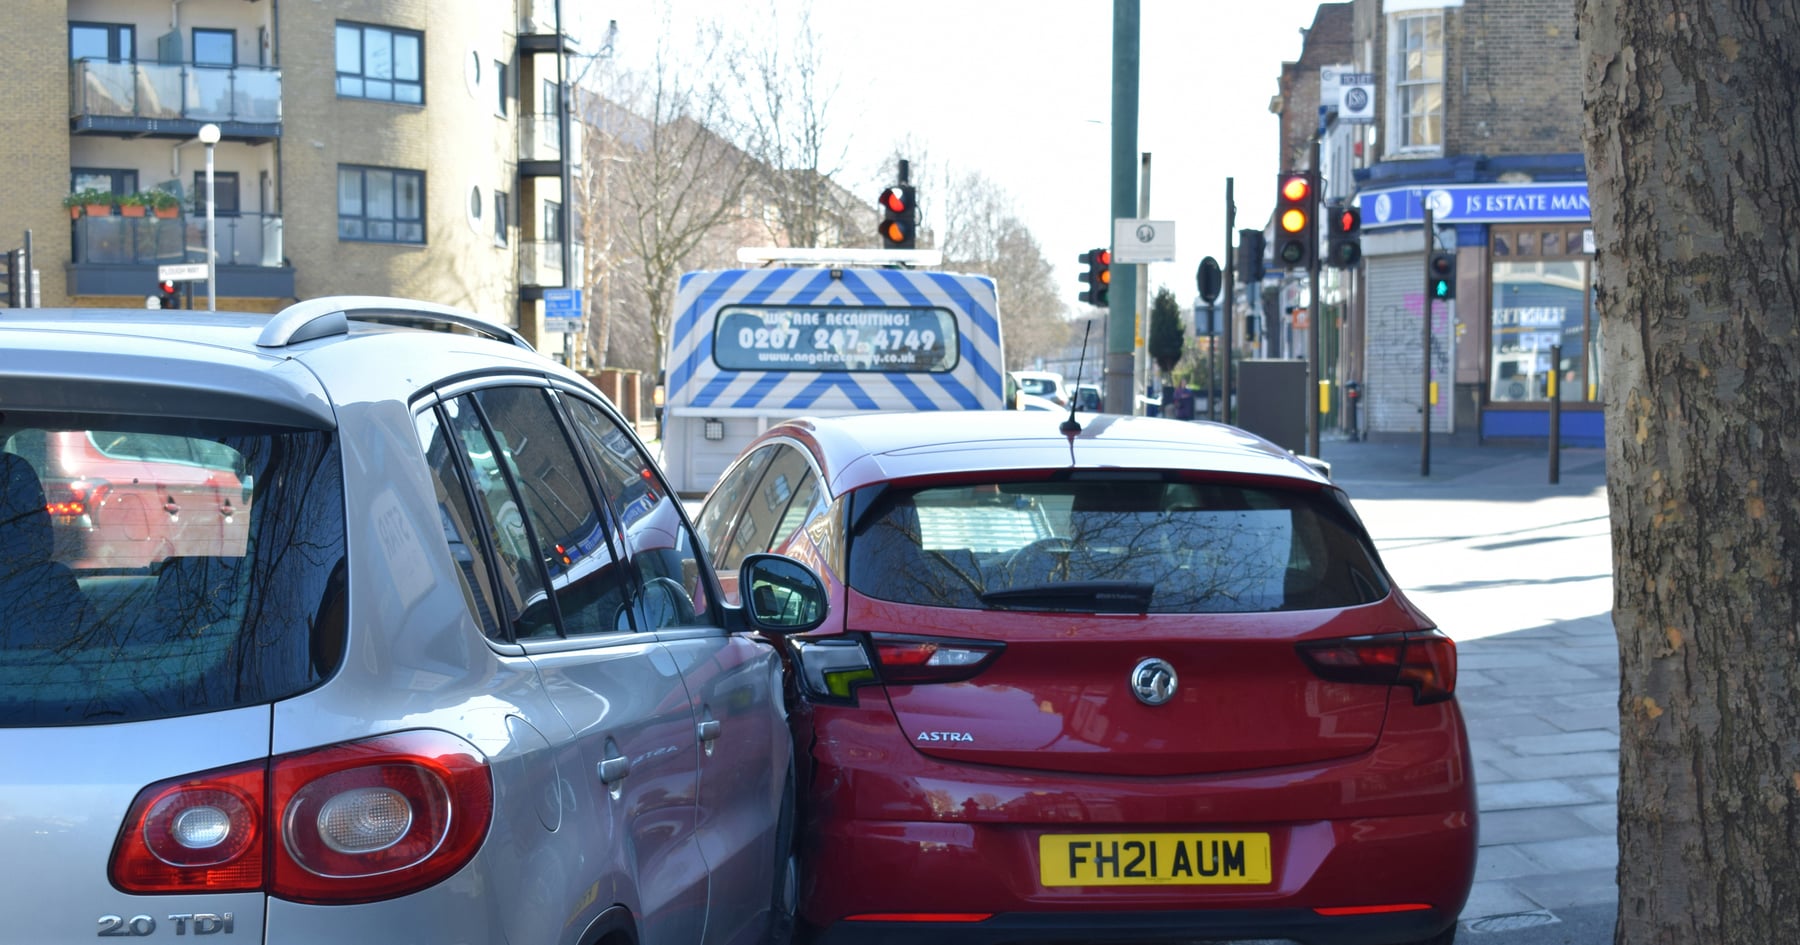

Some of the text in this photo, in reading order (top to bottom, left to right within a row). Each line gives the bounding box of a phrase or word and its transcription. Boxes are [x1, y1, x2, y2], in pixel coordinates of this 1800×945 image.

[1466, 194, 1480, 214] JS
[1486, 194, 1546, 211] ESTATE
[764, 311, 910, 327] WE ARE RECRUITING!
[738, 327, 936, 351] 0207 247 4749
[917, 731, 974, 742] ASTRA
[1068, 840, 1158, 879] FH21
[1171, 840, 1246, 877] AUM
[97, 912, 234, 937] 2.0 TDI
